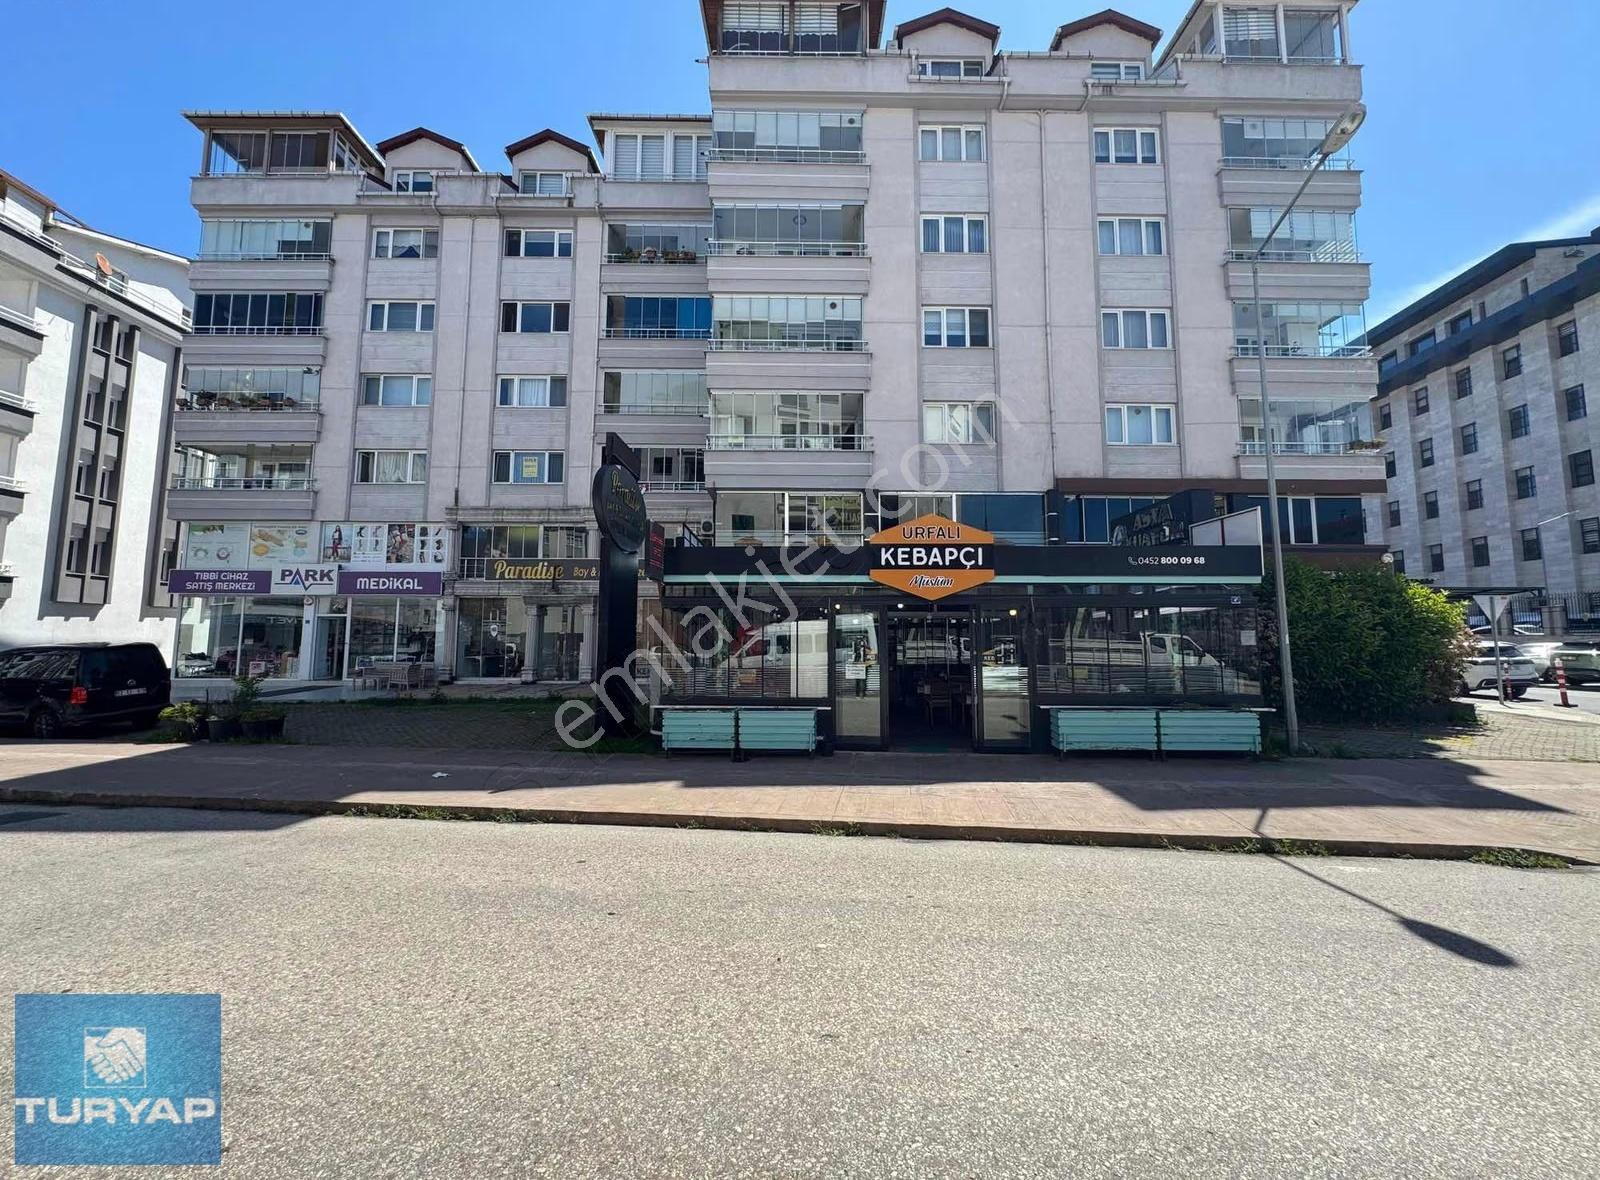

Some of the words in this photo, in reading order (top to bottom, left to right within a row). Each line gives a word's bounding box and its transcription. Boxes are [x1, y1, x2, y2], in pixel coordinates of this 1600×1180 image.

[902, 526, 961, 540] URFALI
[880, 547, 983, 570] KEBAPÇI
[1137, 556, 1159, 565] 0452
[1160, 556, 1178, 565] 800
[1180, 556, 1192, 565] 09
[1193, 556, 1206, 565] 68
[280, 568, 335, 585] PARK
[494, 559, 565, 580] Paradise
[185, 581, 213, 592] SATIŞ
[356, 577, 423, 590] MEDİKAL
